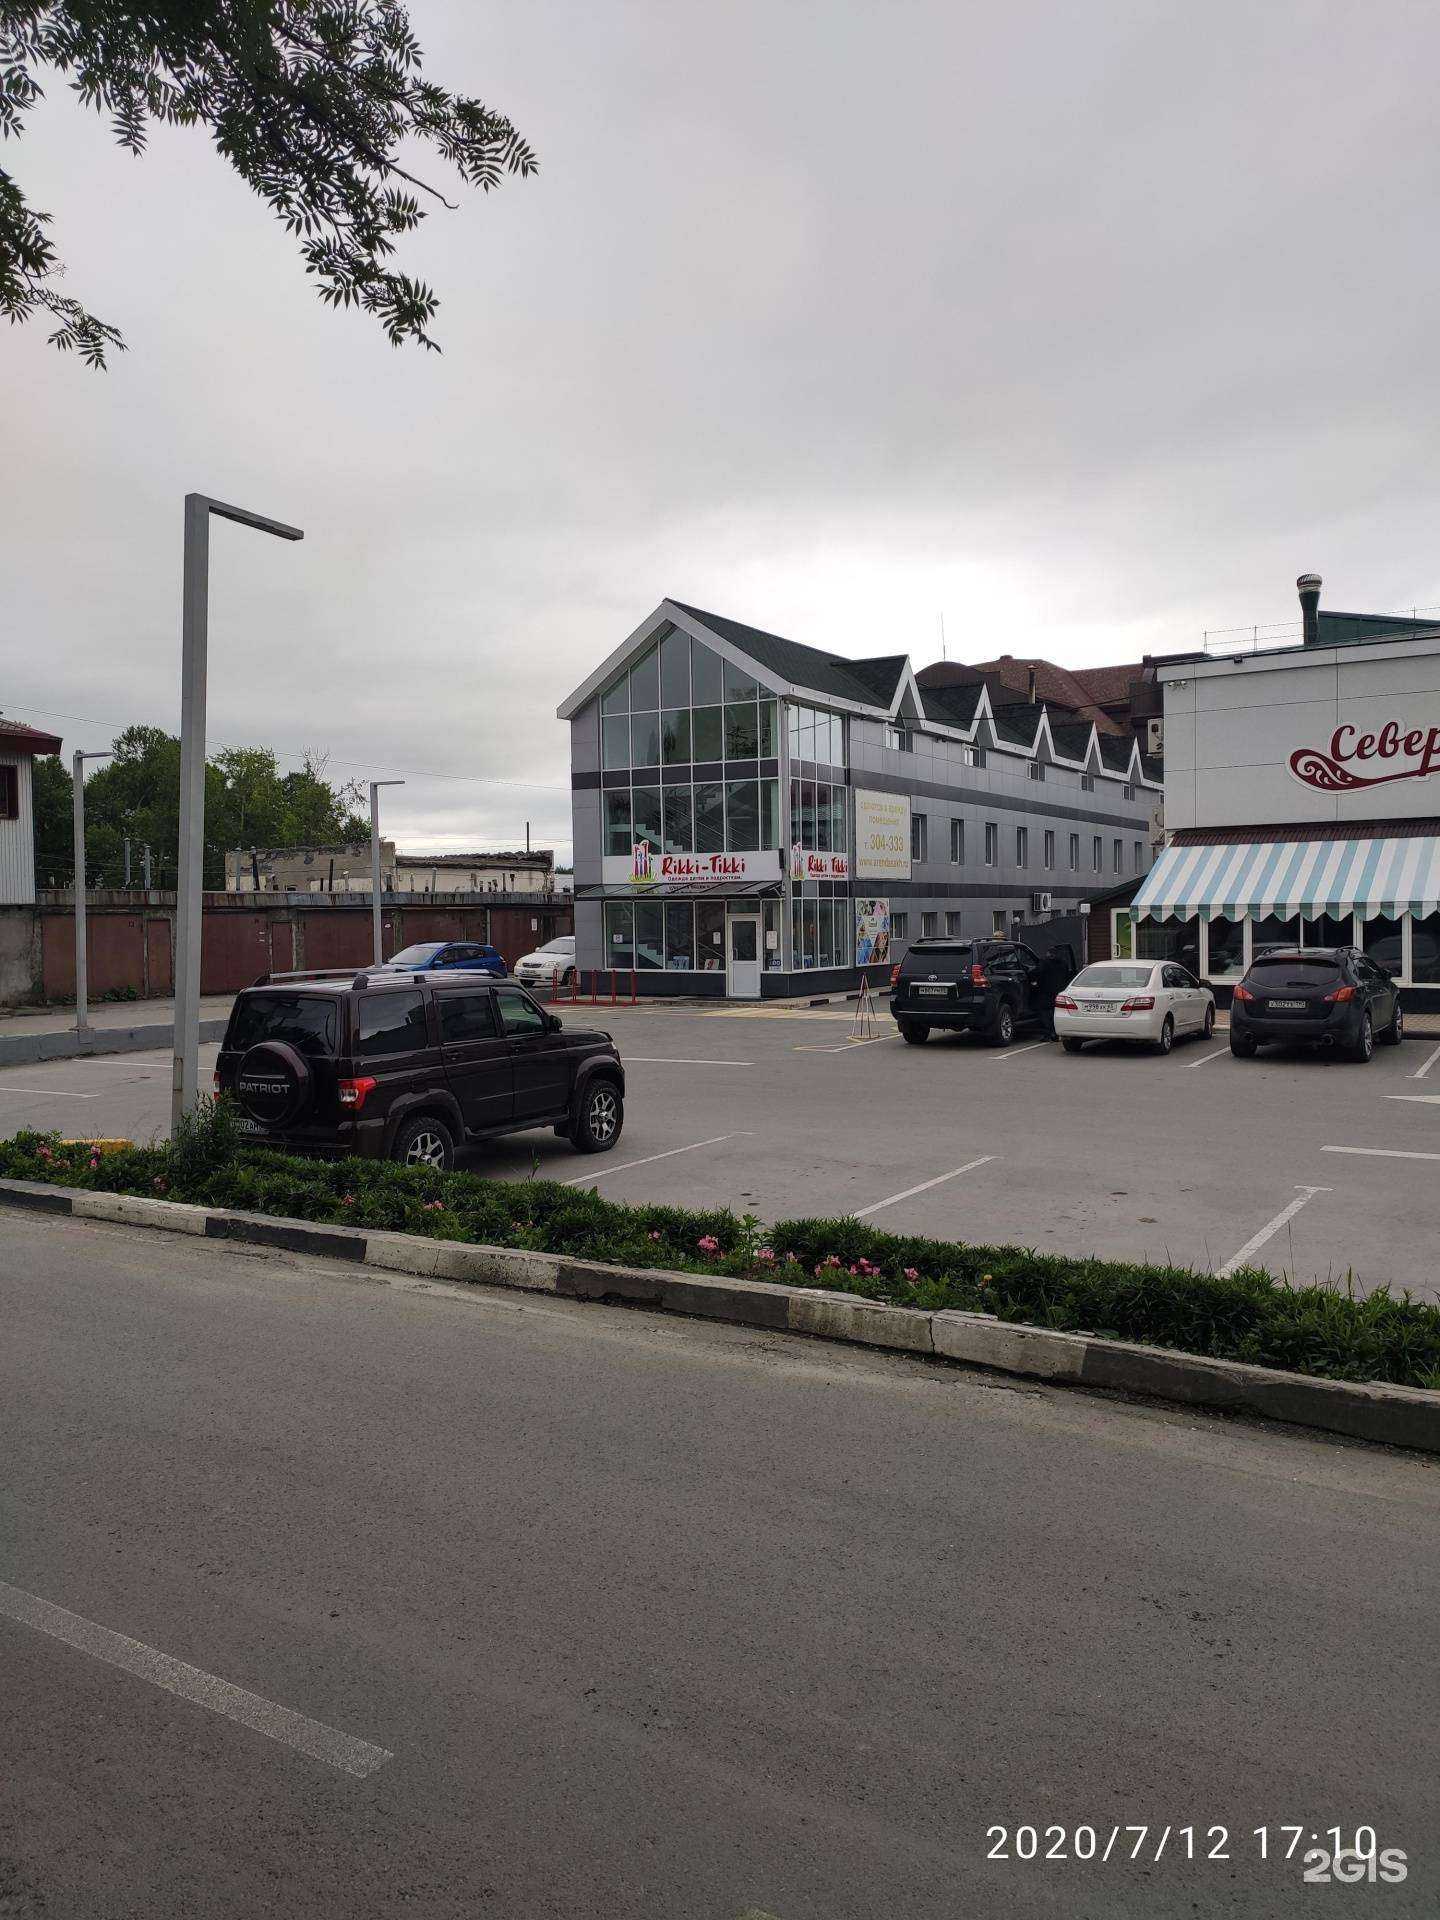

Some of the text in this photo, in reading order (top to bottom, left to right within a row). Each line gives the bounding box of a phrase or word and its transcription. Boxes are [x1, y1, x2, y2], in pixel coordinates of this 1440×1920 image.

[870, 833, 904, 852] 304-333
[661, 854, 746, 876] Rikki-Tikki
[808, 854, 827, 873] Rikki
[240, 1082, 290, 1095] PATRIOT
